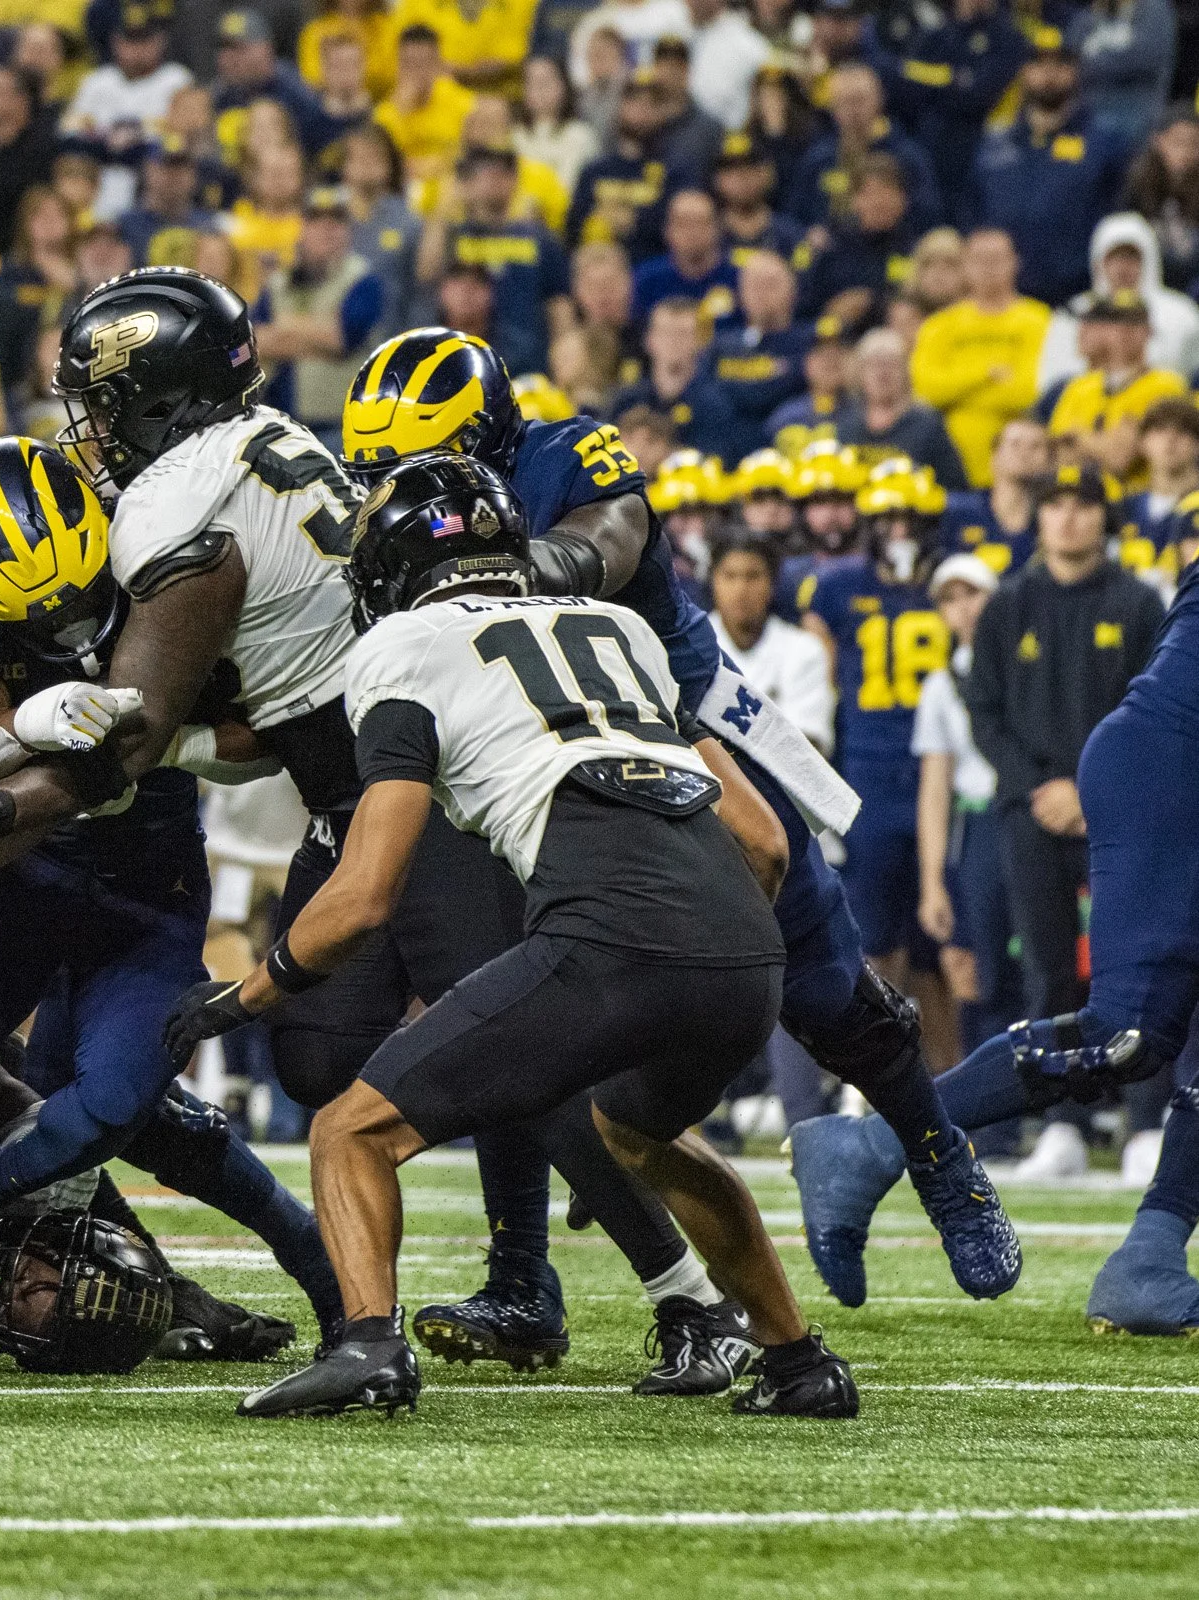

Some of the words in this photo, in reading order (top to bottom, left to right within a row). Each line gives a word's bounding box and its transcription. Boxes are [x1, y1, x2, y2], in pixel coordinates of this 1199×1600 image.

[90, 310, 159, 383] P
[572, 424, 639, 487] 55
[43, 594, 62, 612] M
[469, 611, 699, 746] 10
[856, 610, 947, 712] 18
[721, 684, 763, 736] M
[69, 738, 94, 751] MIC
